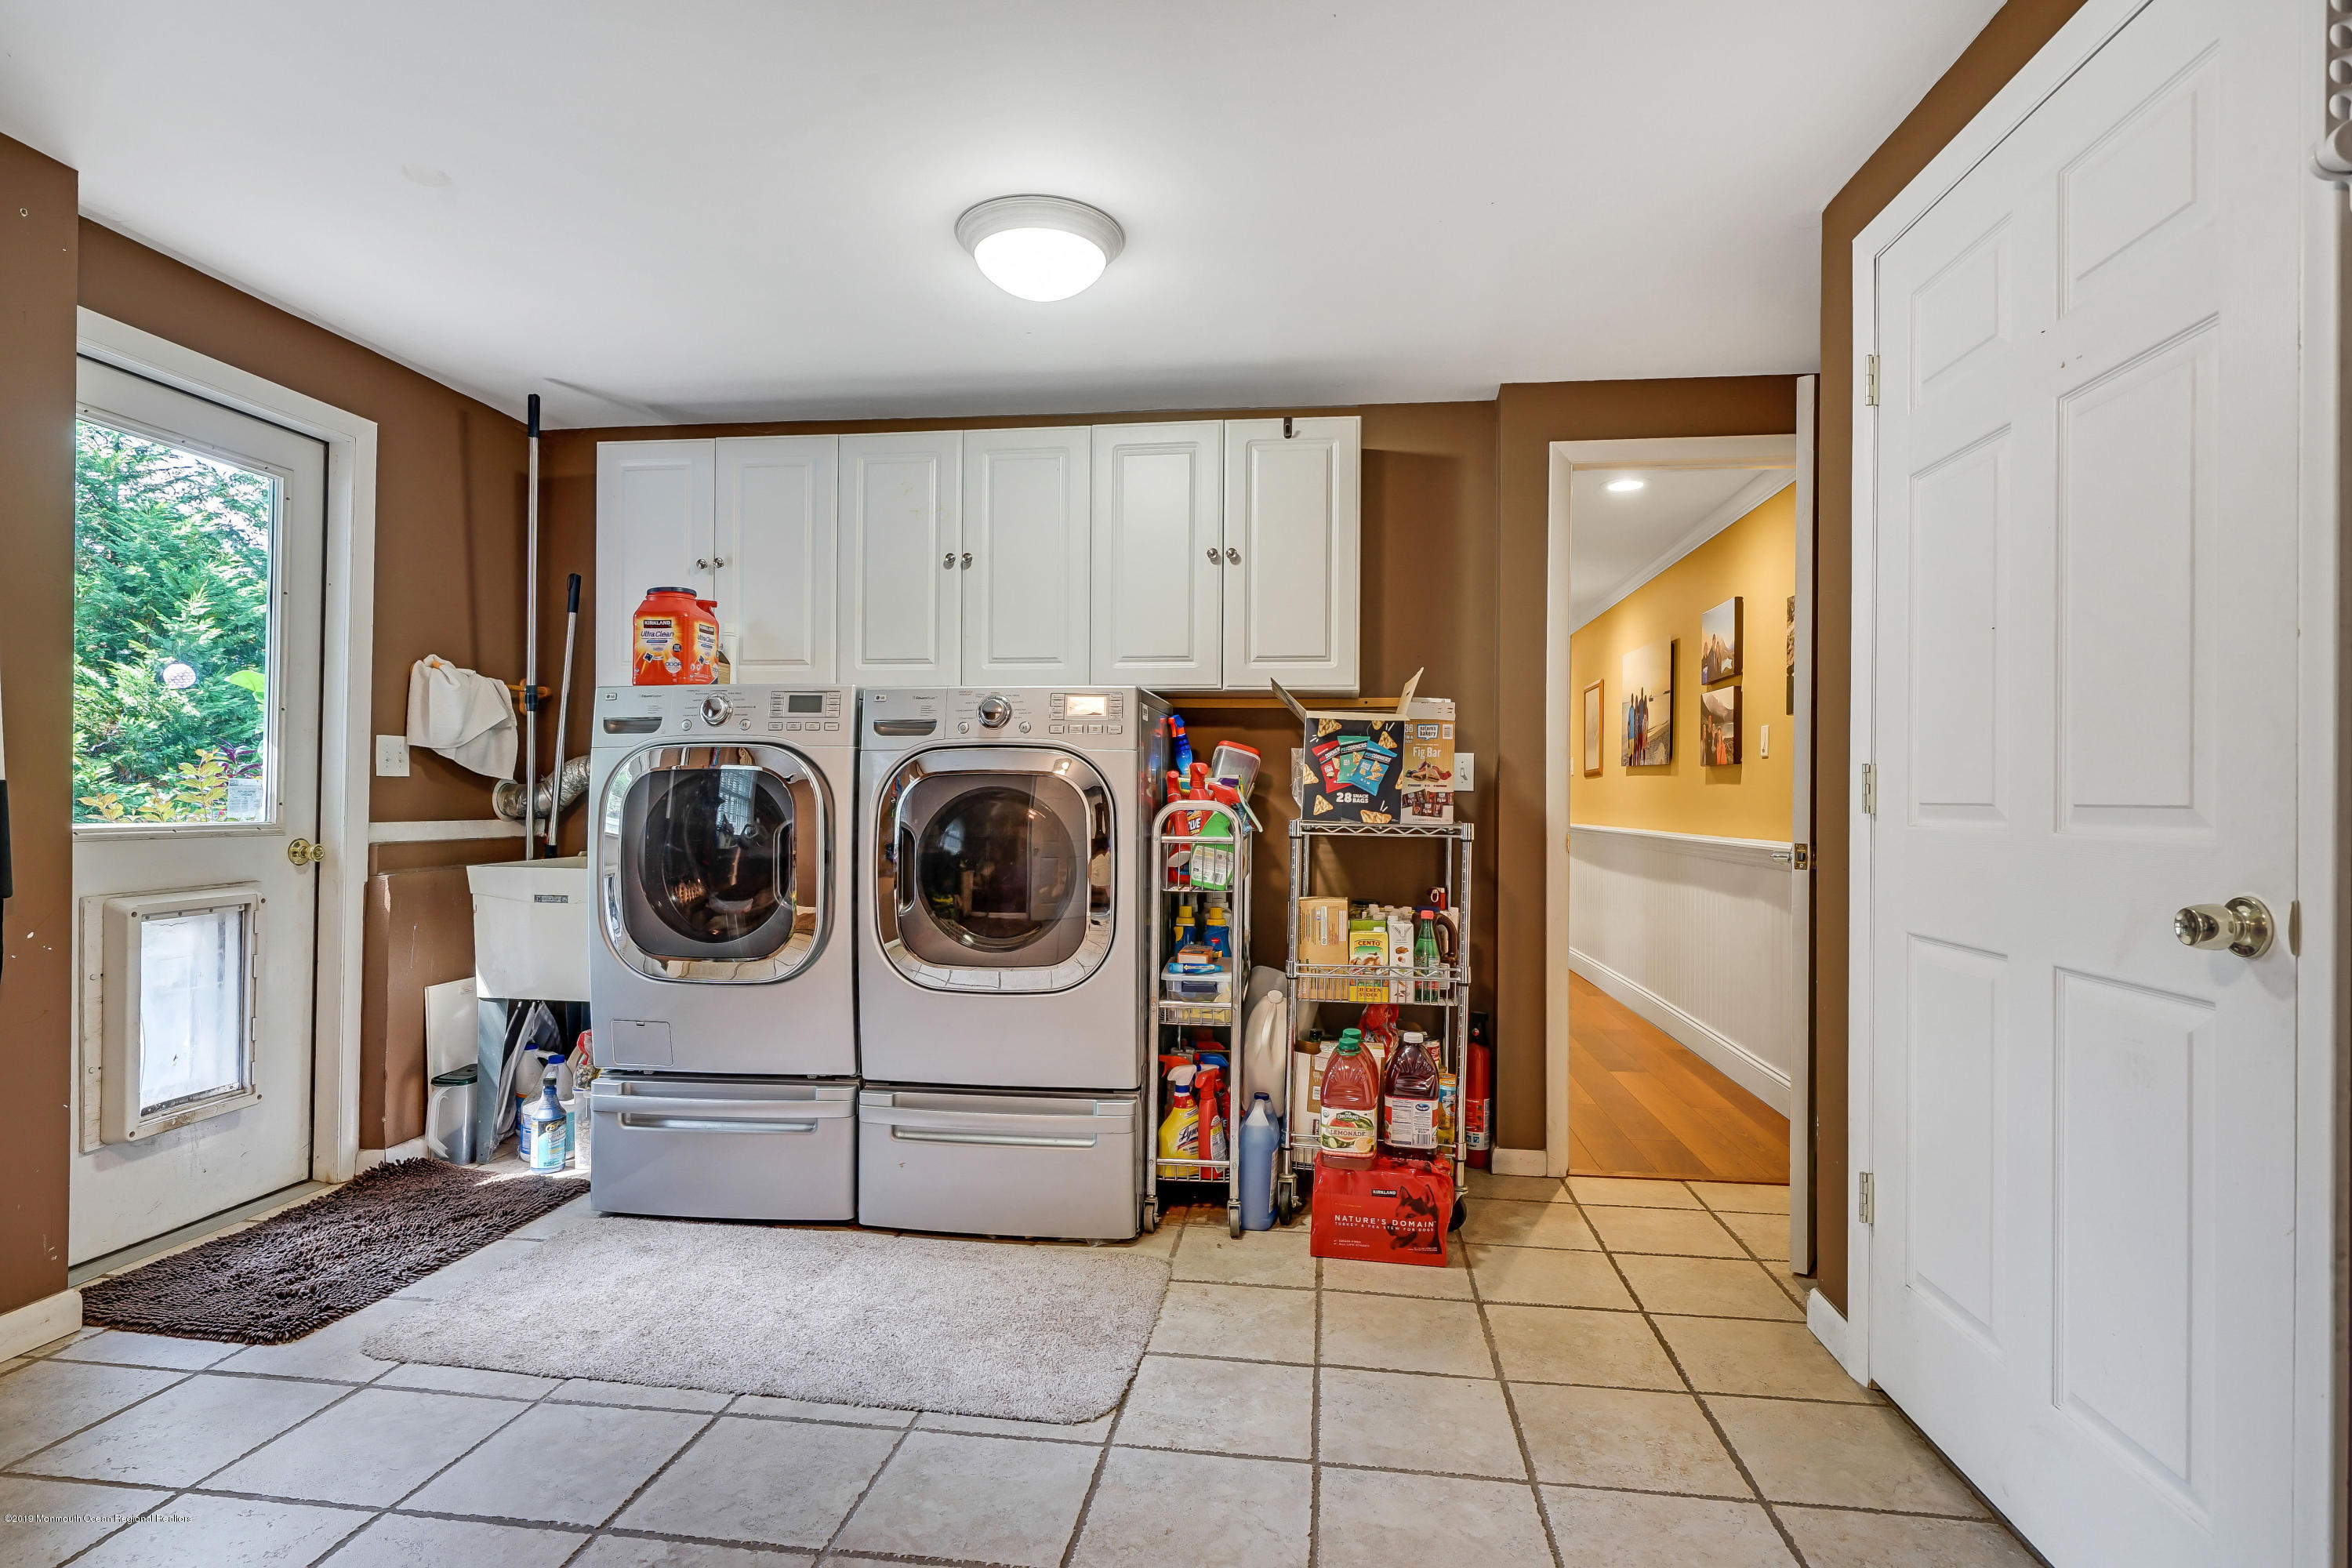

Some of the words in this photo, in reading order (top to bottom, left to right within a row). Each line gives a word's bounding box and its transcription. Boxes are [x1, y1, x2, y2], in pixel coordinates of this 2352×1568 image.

[1413, 746, 1425, 760] Fig
[1427, 746, 1442, 758] Bar
[1336, 792, 1352, 803] 28
[1334, 1214, 1387, 1225] NATURE'S
[1392, 1220, 1434, 1229] DOMAIN
